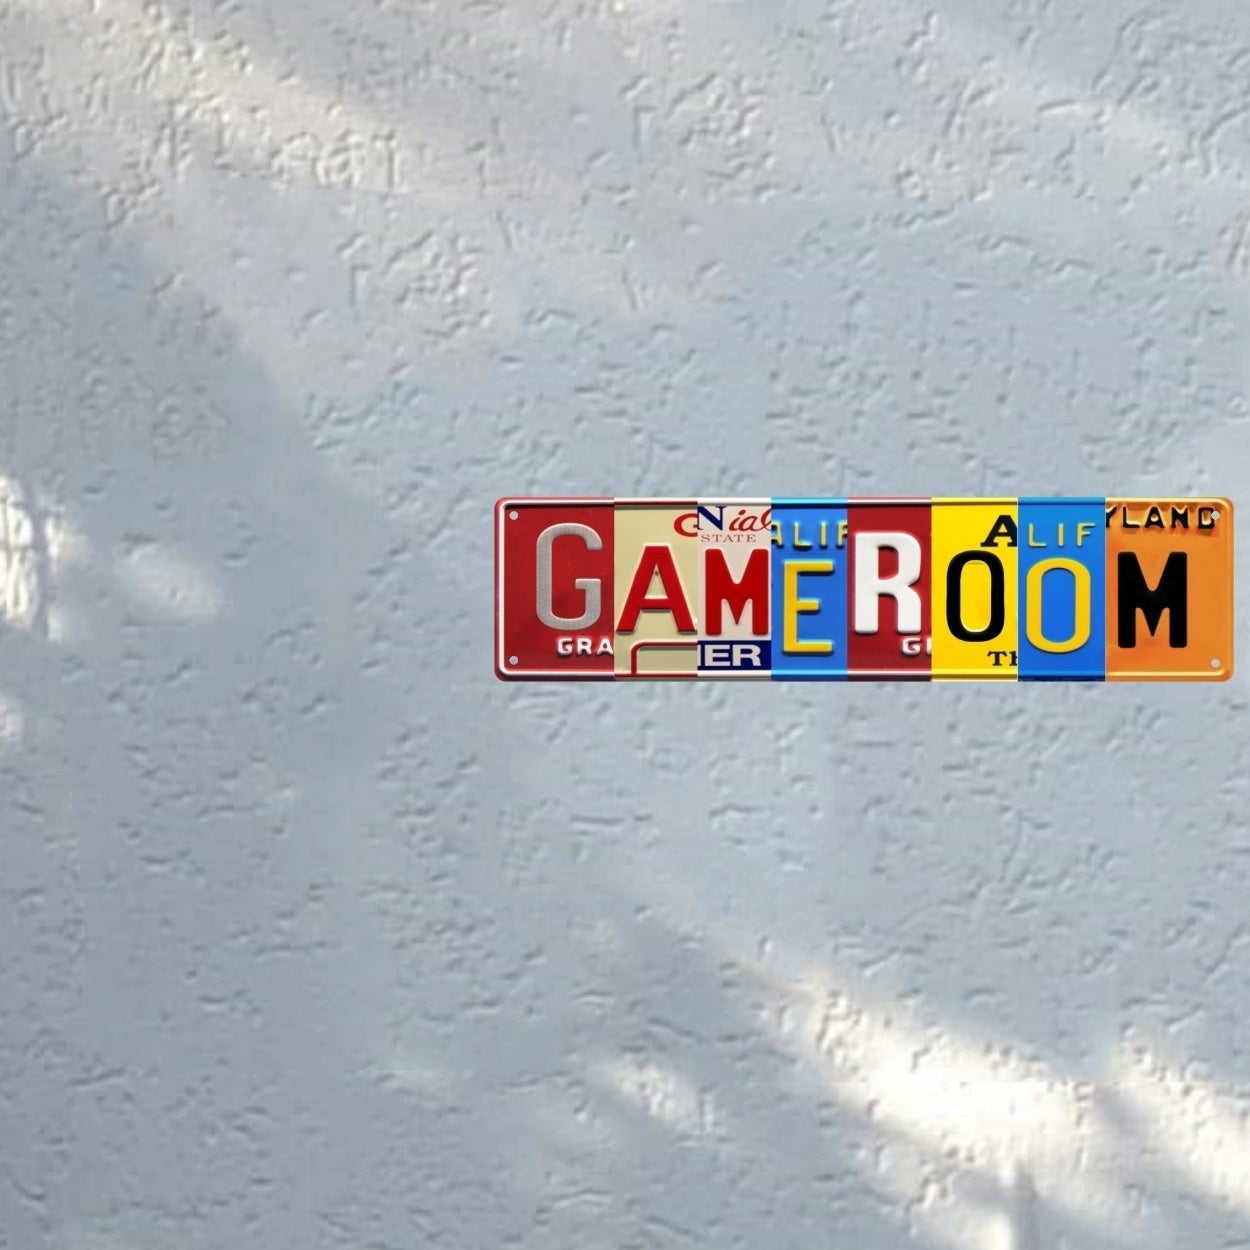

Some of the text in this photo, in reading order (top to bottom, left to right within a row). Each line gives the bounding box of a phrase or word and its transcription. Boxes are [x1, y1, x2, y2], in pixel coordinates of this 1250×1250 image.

[701, 534, 756, 543] STATE
[1027, 522, 1096, 547] LIF
[556, 637, 614, 656] GRA
[697, 644, 761, 667] ER
